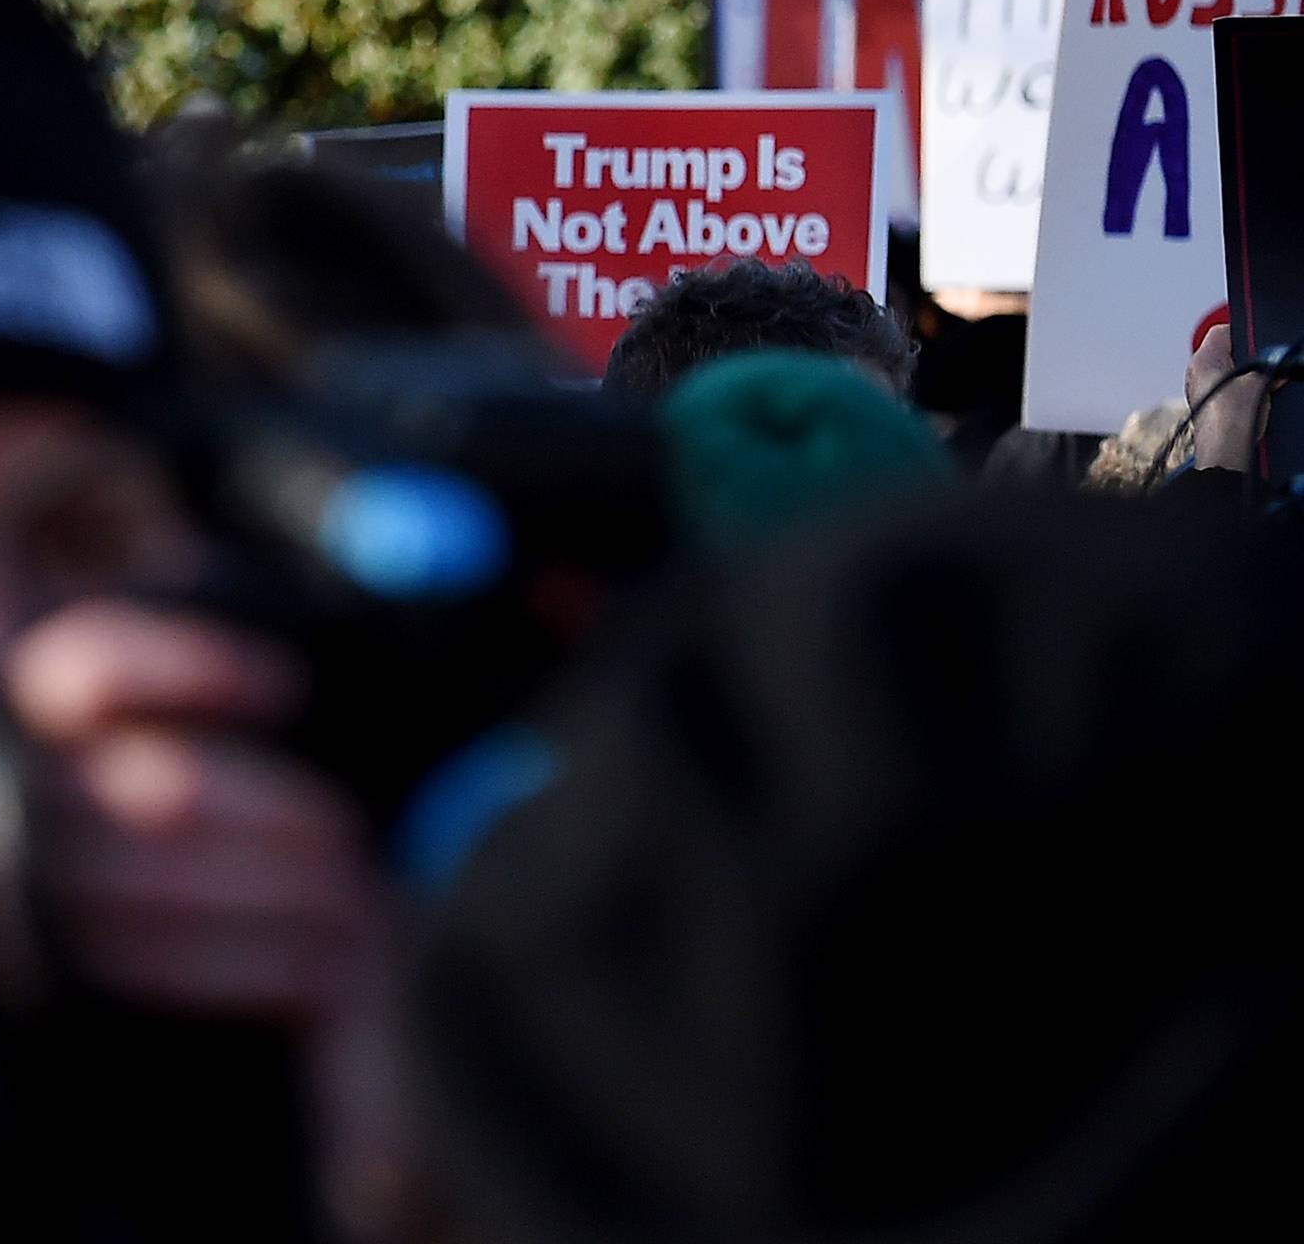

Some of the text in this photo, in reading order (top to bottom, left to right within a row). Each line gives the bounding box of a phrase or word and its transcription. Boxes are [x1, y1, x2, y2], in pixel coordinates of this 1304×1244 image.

[543, 132, 806, 203] Trump Is
[512, 197, 830, 256] Not Above
[537, 261, 656, 319] The
